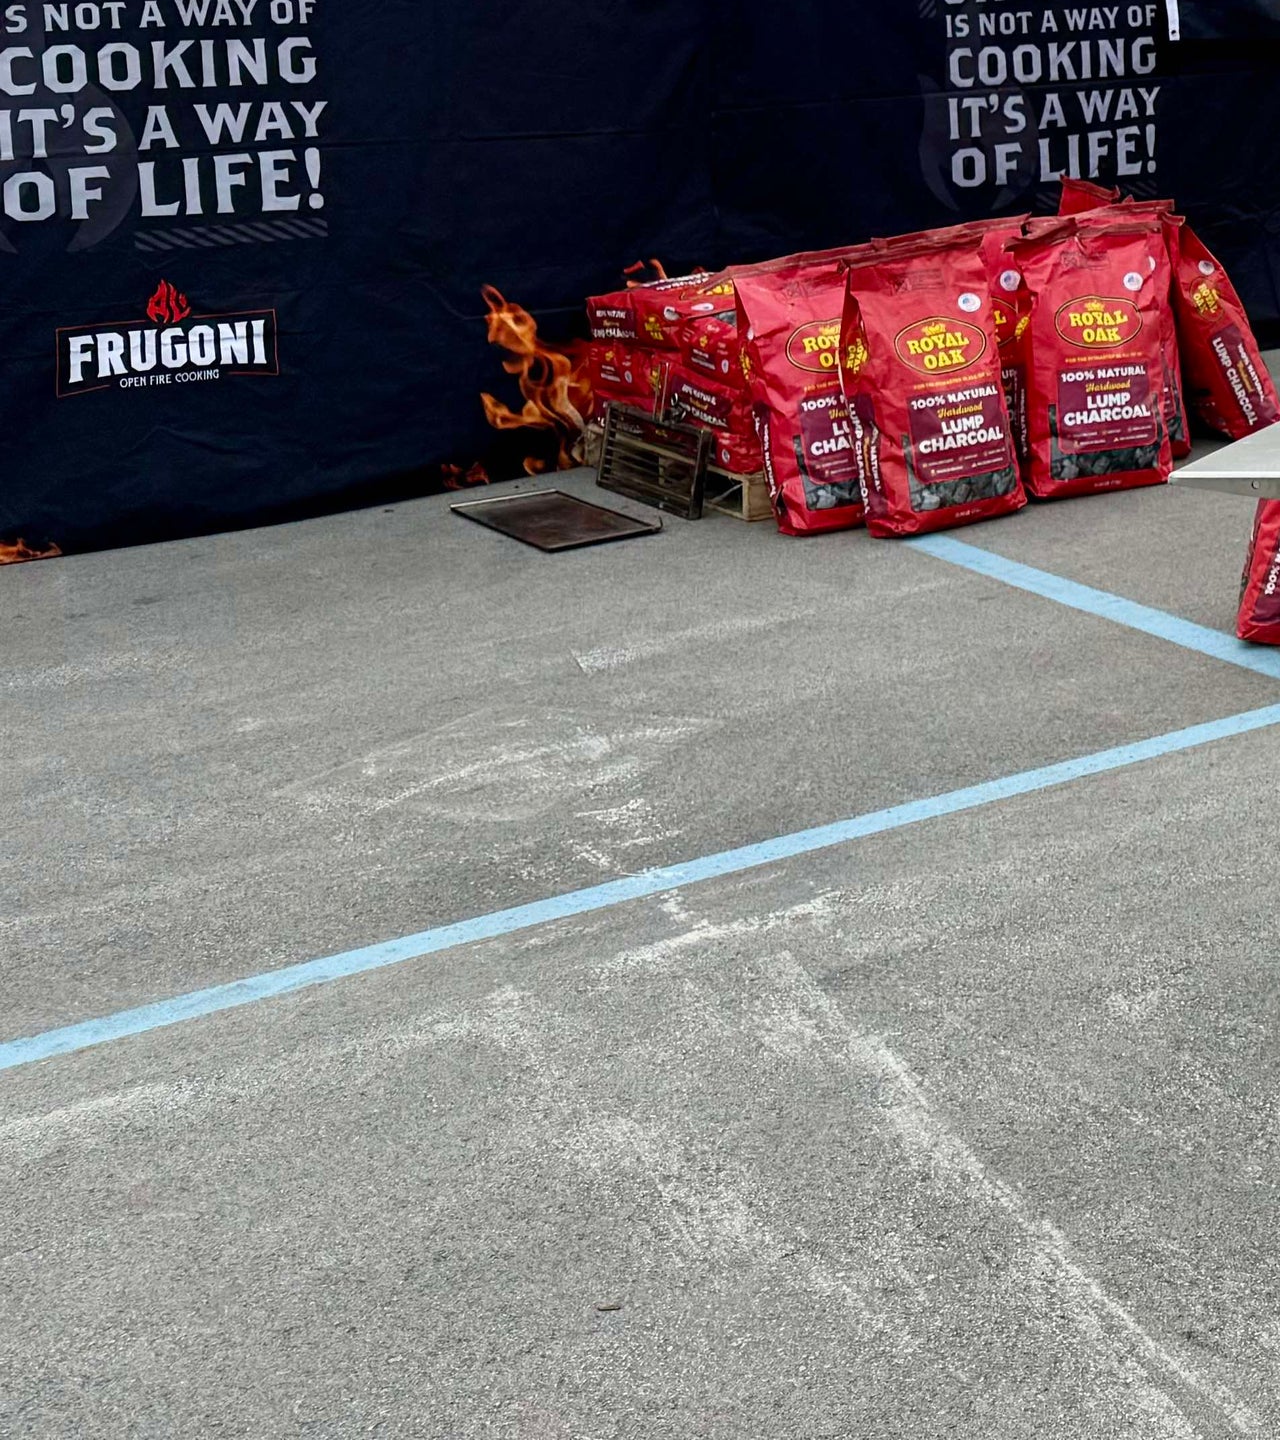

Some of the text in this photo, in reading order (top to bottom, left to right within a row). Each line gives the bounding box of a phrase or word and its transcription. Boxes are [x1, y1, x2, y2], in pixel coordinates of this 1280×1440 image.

[42, 2, 127, 32] NOT
[138, 0, 167, 29] A
[174, 0, 258, 28] WAY
[945, 4, 1158, 38] IS NOT A WAY OF
[0, 36, 317, 97] COOKING
[949, 36, 1157, 89] COOKING
[948, 86, 1162, 141] IT'S A WAY
[137, 105, 181, 151] A
[193, 101, 329, 146] WAY
[951, 123, 1157, 188] OF LIFE!
[2, 147, 325, 222] OF LIFE!
[1069, 310, 1129, 328] ROYAL
[803, 335, 841, 354] ROY
[906, 331, 970, 355] ROYAL
[1082, 327, 1122, 343] OAK
[68, 319, 268, 385] FRUGONI
[923, 348, 966, 370] OAK
[119, 368, 220, 388] OPEN FIRE COOKING
[1060, 365, 1146, 383] 100% NATURAL
[1085, 379, 1132, 393] Hardwood
[1211, 336, 1259, 427] LUMP CHARCOAL
[801, 394, 838, 411] 100%
[910, 385, 998, 410] 100% NATURAL
[1086, 391, 1132, 410] LUMP
[937, 400, 984, 420] Hardwood
[1063, 404, 1152, 427] CHARCOAL
[941, 414, 985, 435] LUMP
[918, 425, 1004, 455] CHARCOAL
[1263, 564, 1280, 596] 100%
